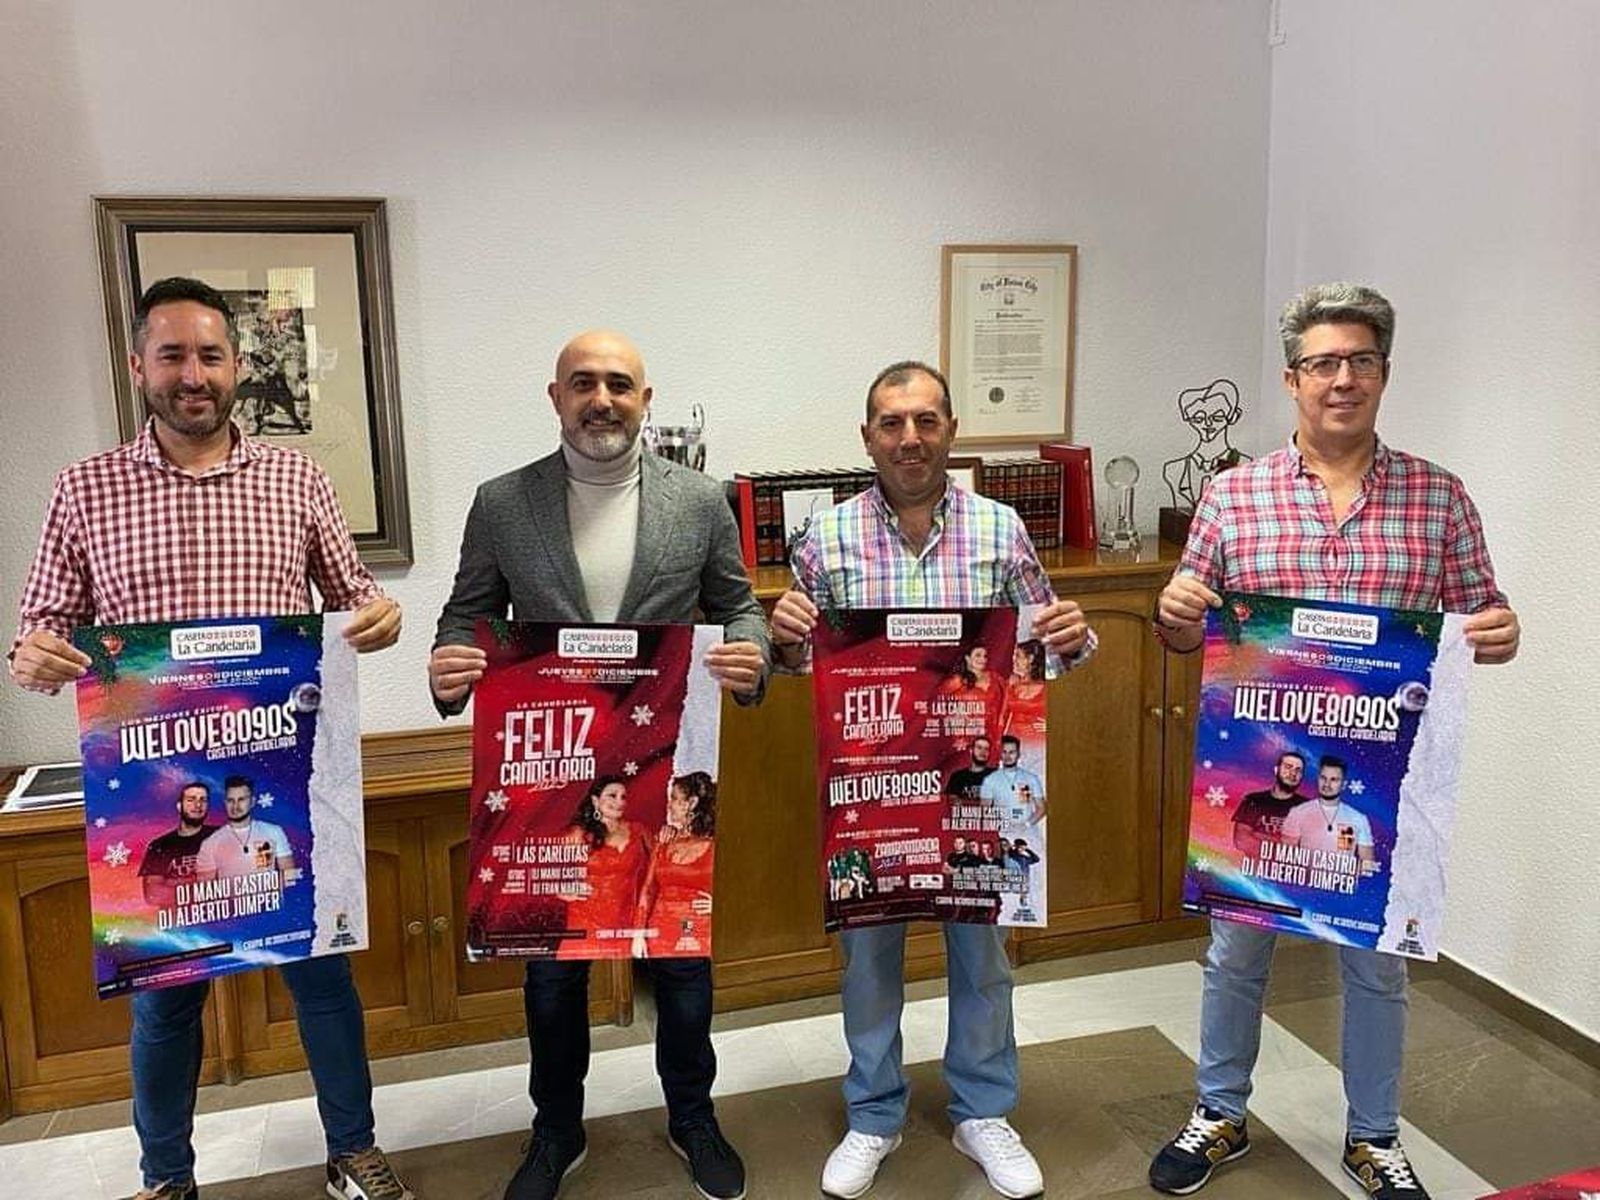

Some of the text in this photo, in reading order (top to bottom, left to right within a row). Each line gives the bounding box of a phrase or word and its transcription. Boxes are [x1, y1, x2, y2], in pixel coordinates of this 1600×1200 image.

[891, 626, 958, 637] La Candelaria
[1298, 623, 1372, 640] La Candelaria
[178, 640, 256, 655] La Candelaria
[564, 641, 633, 654] La Candelaria
[844, 687, 902, 724] FELIZ
[1234, 686, 1400, 730] WELOVE8090S
[120, 703, 298, 764] WELOVE8090S
[504, 707, 596, 762] FELIZ
[843, 719, 904, 741] CANDELARIA
[1308, 724, 1336, 738] CASETA
[1338, 727, 1348, 739] LA
[206, 743, 237, 761] CASETA
[238, 742, 249, 756] LA
[500, 757, 596, 786] CANDELARIA
[829, 770, 942, 807] WELOVE8090S
[516, 846, 536, 864] LAS
[538, 845, 589, 863] CARLOTAS
[1260, 841, 1273, 859] DJ
[1275, 845, 1310, 867] MANU
[1312, 850, 1357, 875] CASTRO
[177, 884, 191, 906] DJ
[193, 880, 231, 903] MANU
[234, 870, 280, 896] CASTRO
[1242, 857, 1255, 876] DJ
[1256, 861, 1305, 886] ALBERTO
[1308, 869, 1355, 894] JUMPER
[158, 891, 280, 930] DJ ALBERTO JUMPER
